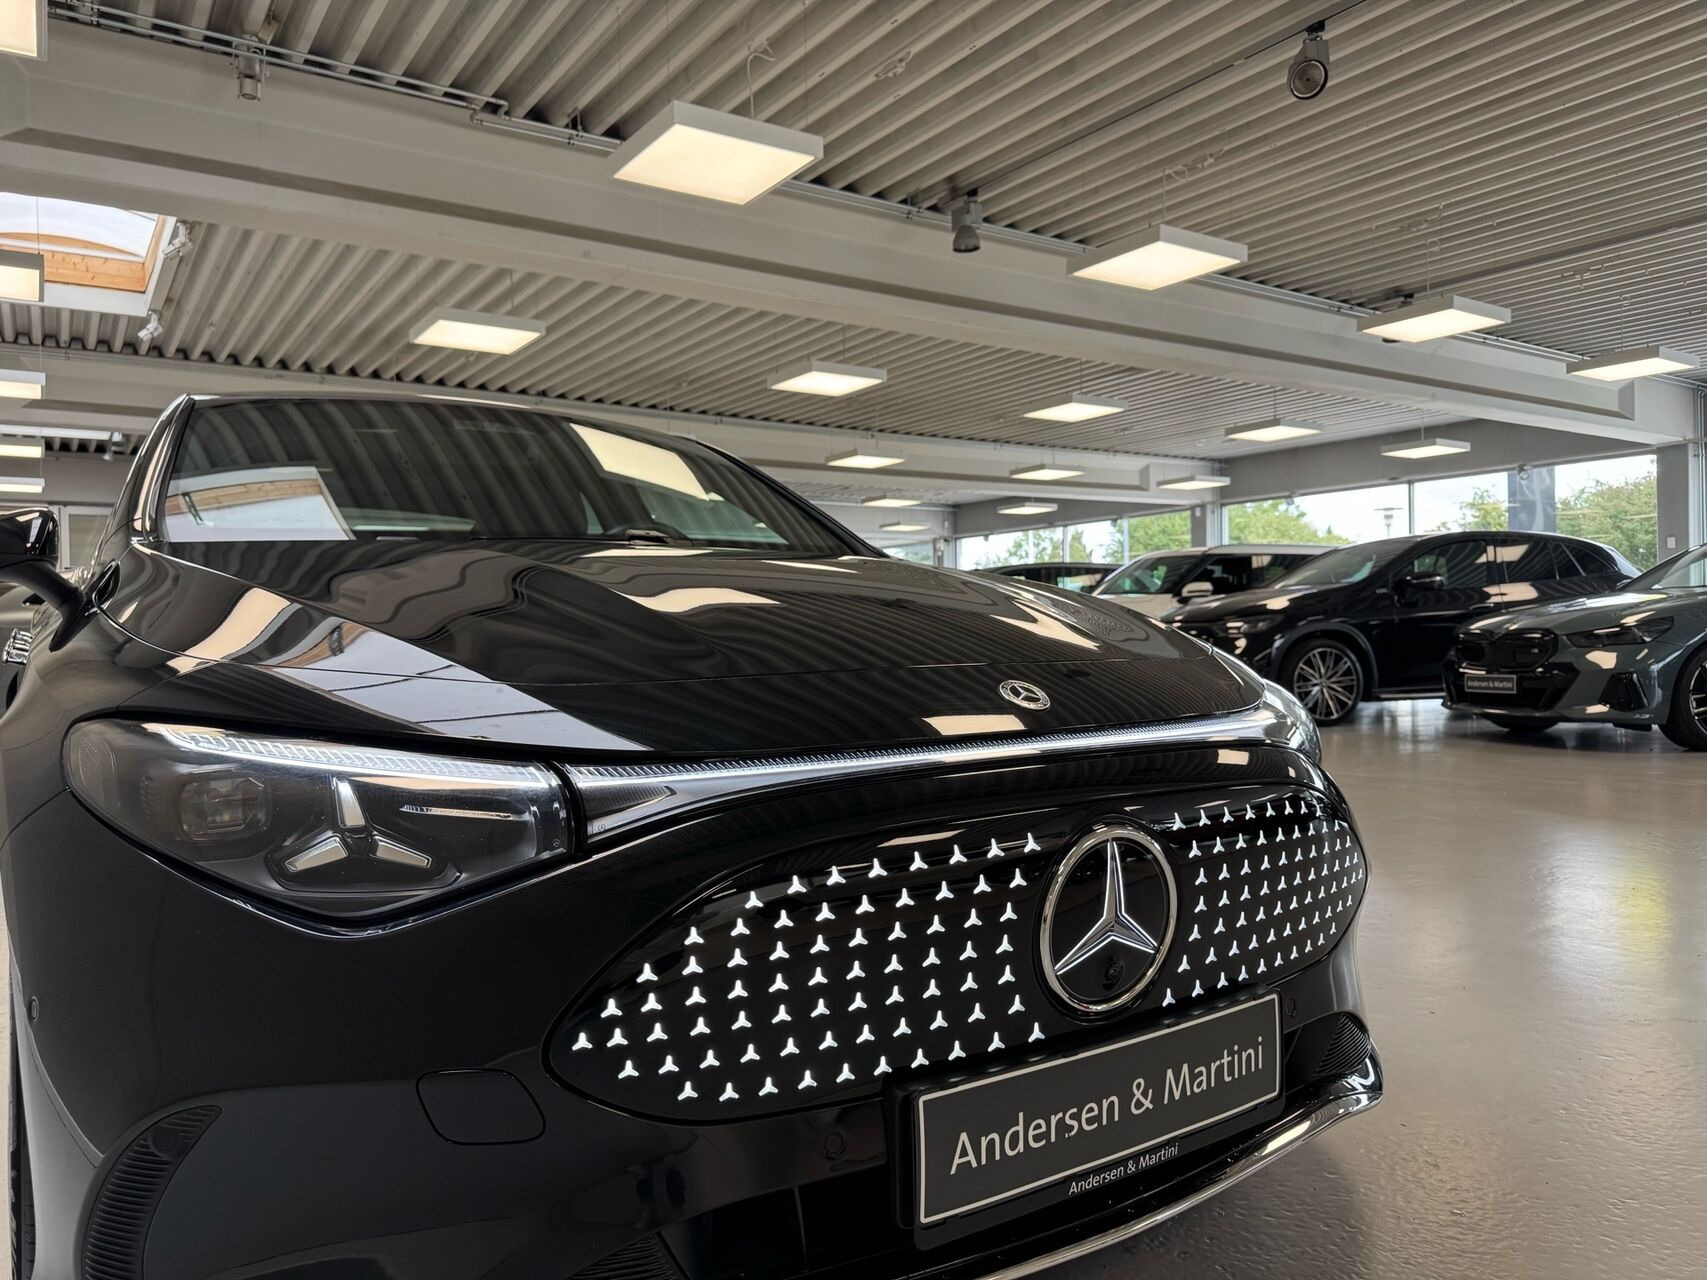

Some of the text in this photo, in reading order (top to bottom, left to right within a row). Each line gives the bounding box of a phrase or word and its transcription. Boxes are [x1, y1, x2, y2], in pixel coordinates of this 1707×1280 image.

[950, 1037, 1263, 1175] Andersen & Martini
[1068, 1142, 1179, 1195] Andersen & Martini
